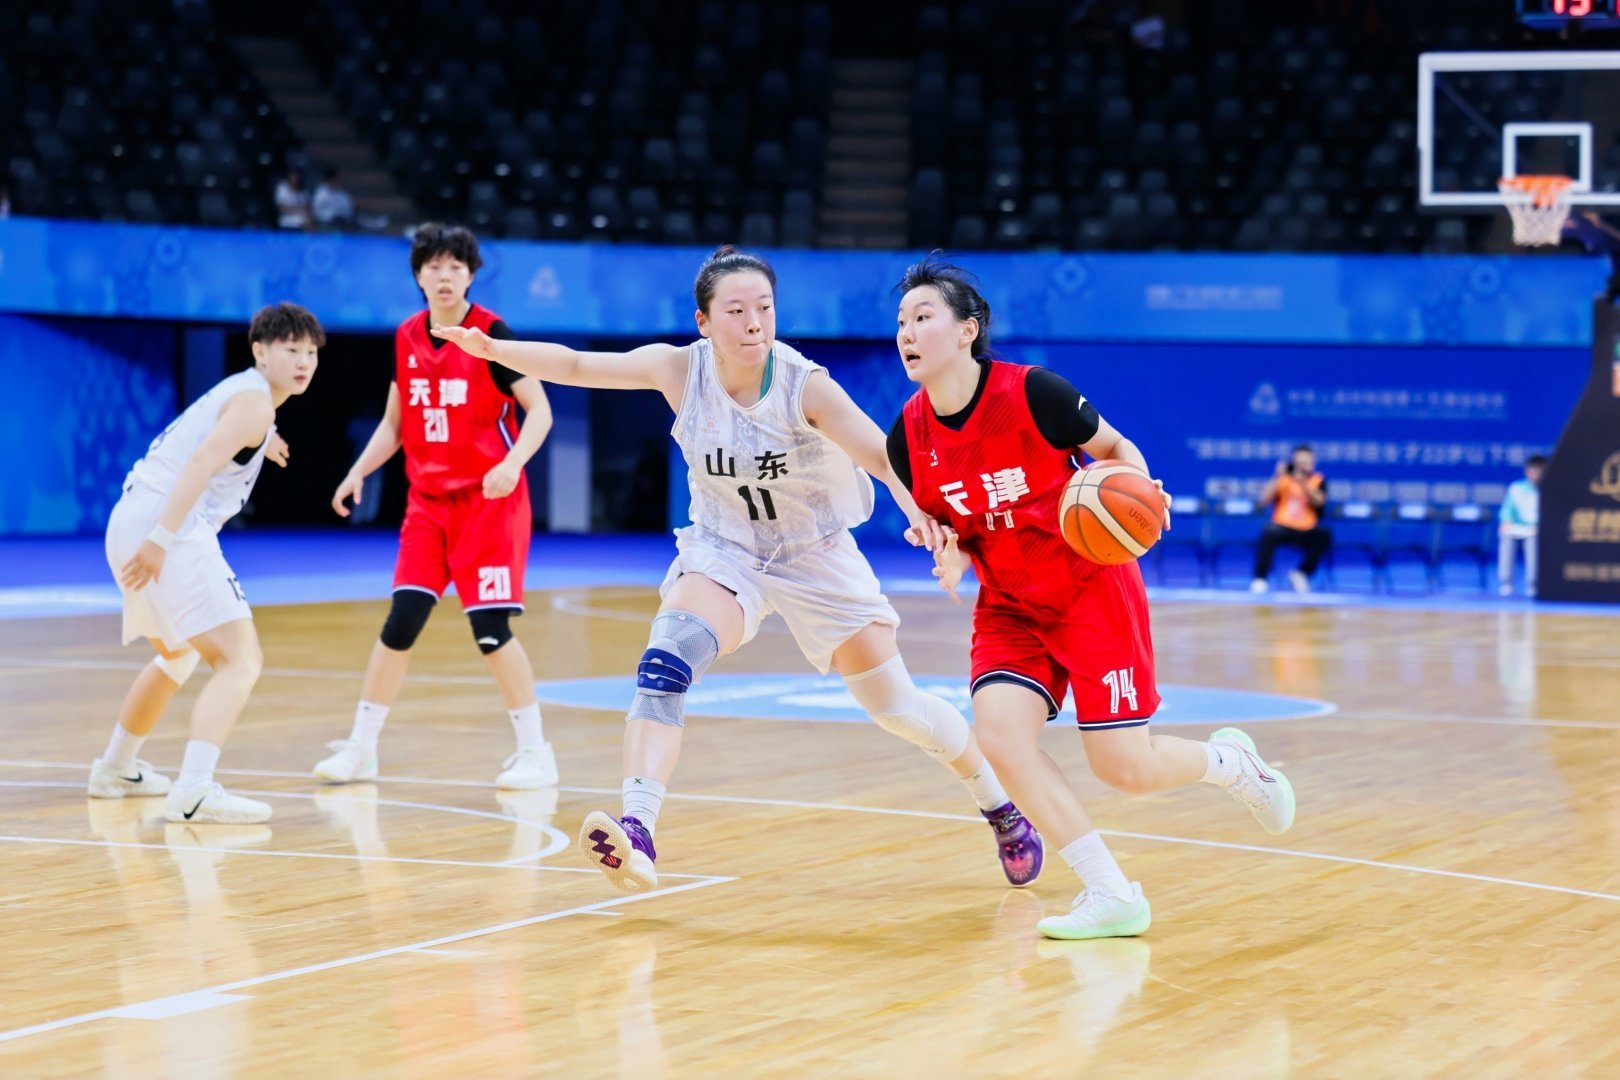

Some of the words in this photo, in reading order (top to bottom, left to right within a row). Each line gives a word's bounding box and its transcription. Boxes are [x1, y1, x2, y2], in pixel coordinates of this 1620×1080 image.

[408, 378, 469, 407] 天津
[423, 408, 450, 443] 20
[705, 448, 789, 481] 山东
[737, 485, 777, 521] 11
[939, 466, 1031, 517] 天津
[478, 566, 512, 601] 20
[1101, 666, 1139, 714] 14
